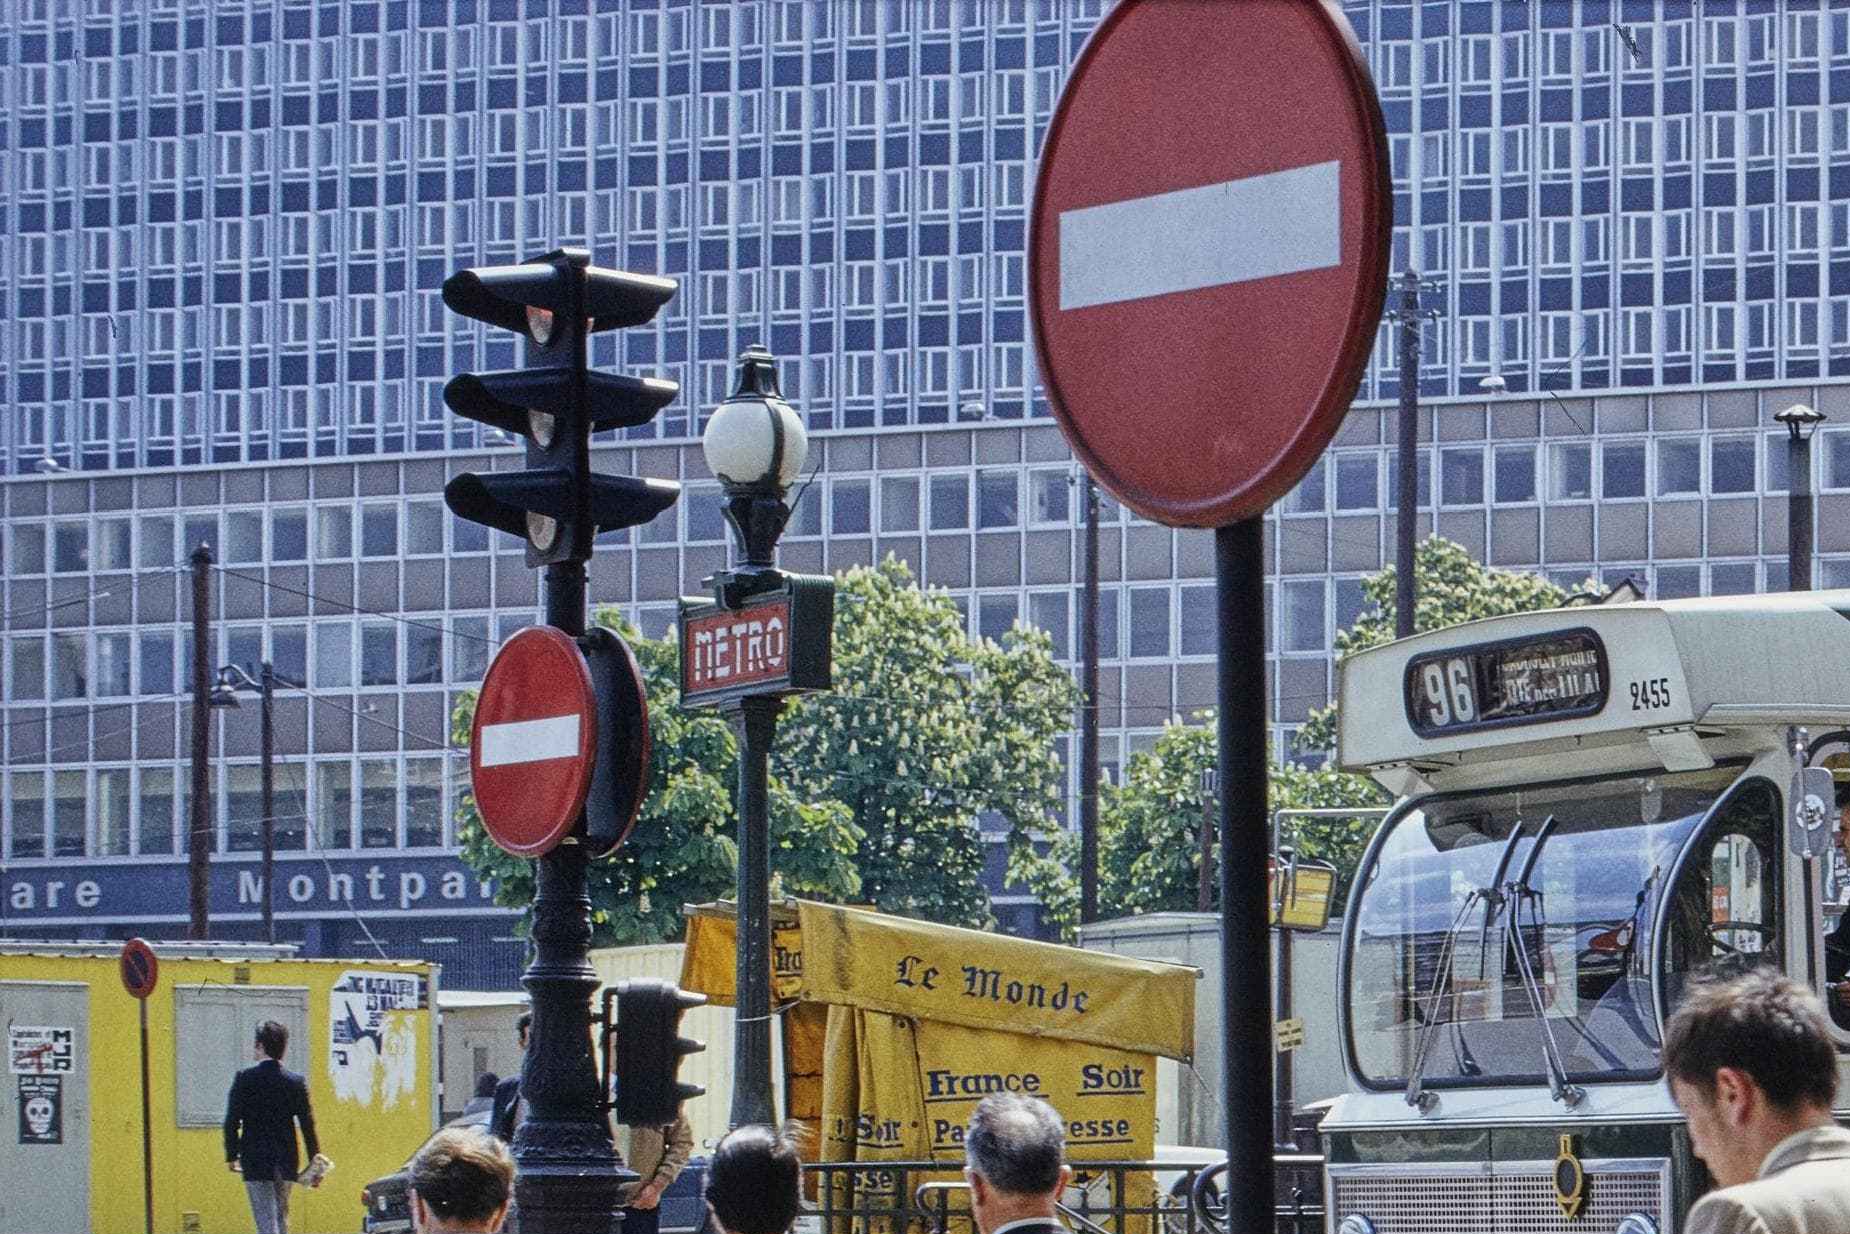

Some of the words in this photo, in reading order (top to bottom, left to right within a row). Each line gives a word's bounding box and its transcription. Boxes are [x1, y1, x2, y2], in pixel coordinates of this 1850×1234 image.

[694, 616, 784, 681] METRO
[1424, 658, 1475, 727] 96
[1630, 677, 1671, 711] 2455
[895, 954, 940, 990] Le
[961, 964, 1089, 1015] Monde
[926, 1069, 1040, 1097] France
[1082, 1063, 1145, 1090] Soir
[1066, 1116, 1130, 1139] esse
